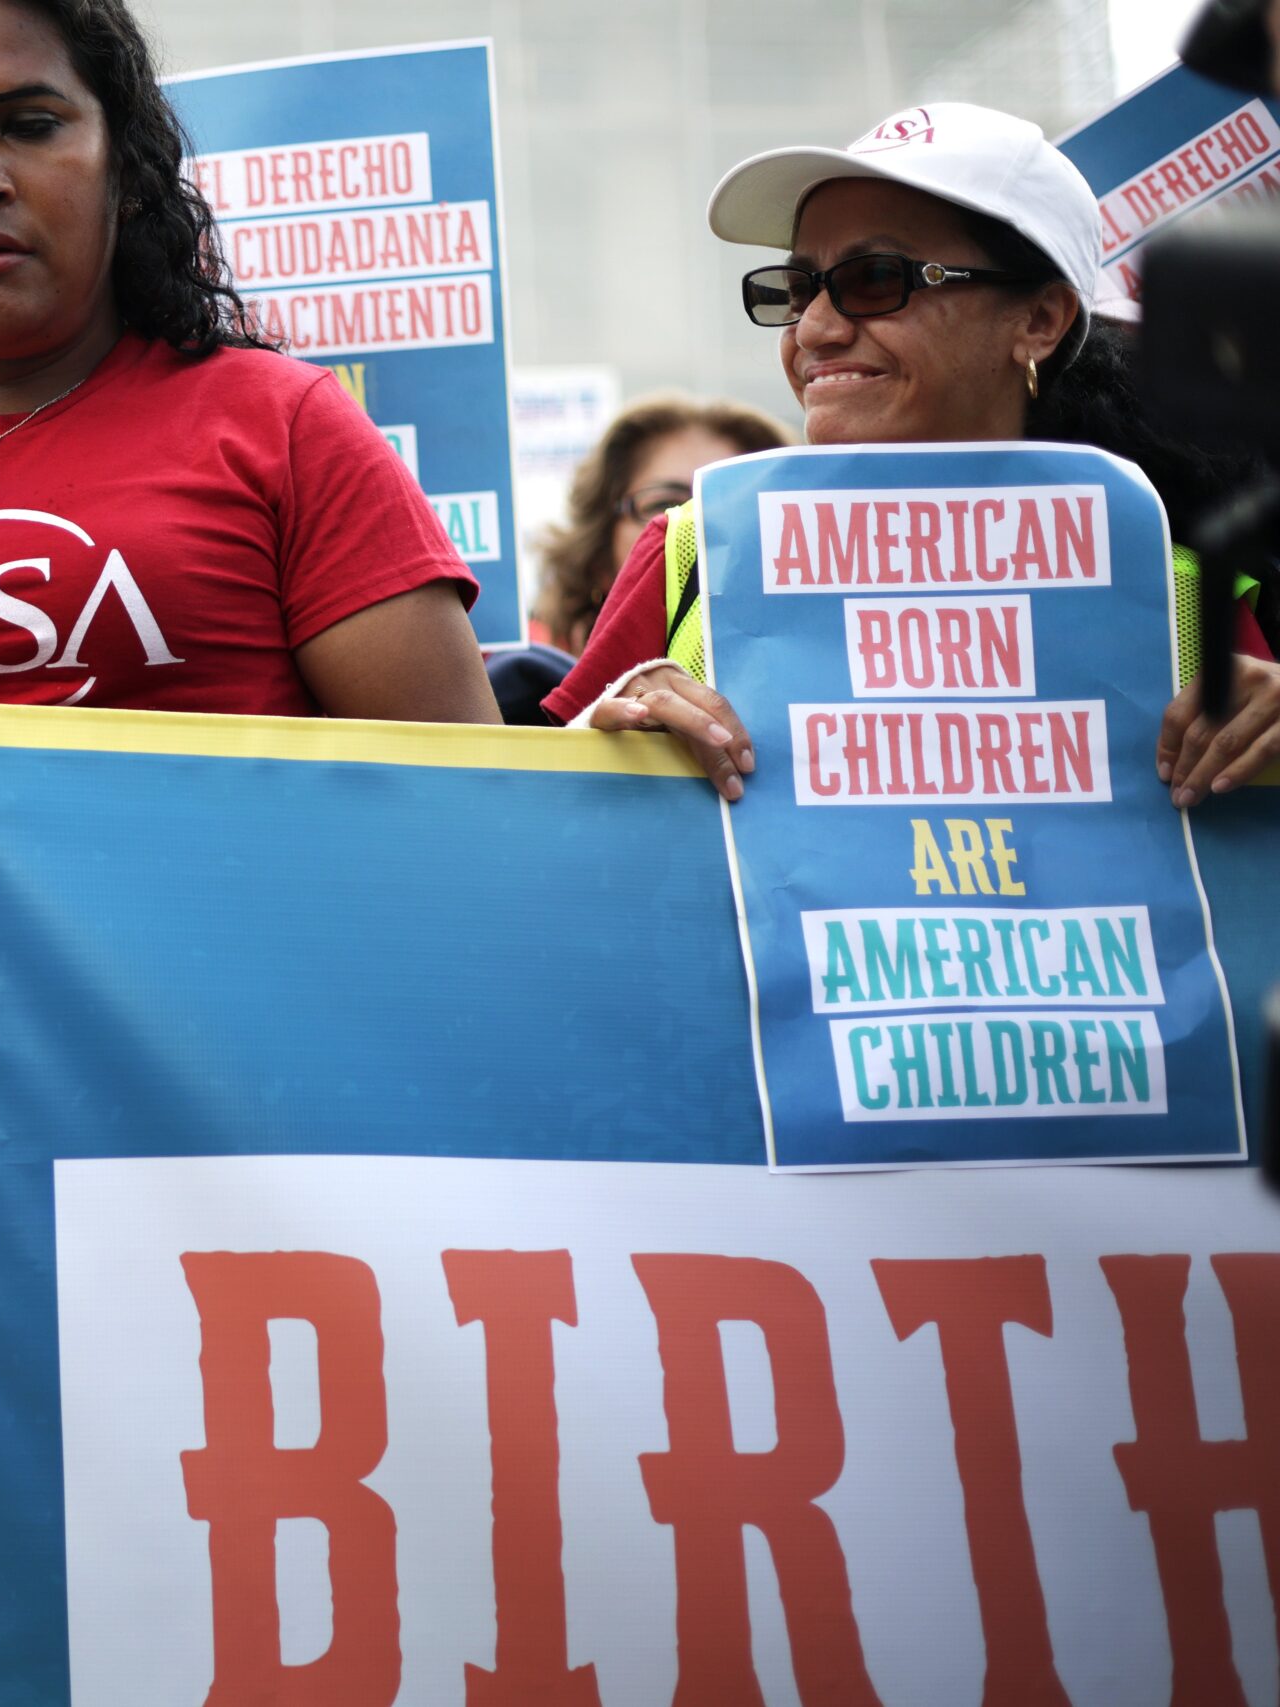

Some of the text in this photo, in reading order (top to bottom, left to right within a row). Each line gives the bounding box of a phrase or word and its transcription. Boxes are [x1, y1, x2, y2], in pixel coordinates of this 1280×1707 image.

[243, 140, 415, 208] DERECHO
[1120, 111, 1271, 228] DERECHO
[232, 201, 483, 282] CIUDADANÍA
[773, 496, 1098, 587] AMERICAN
[857, 605, 1022, 690] BORN
[805, 711, 1095, 796] CHILDREN
[909, 818, 1027, 896] ARE
[821, 917, 1150, 1004] AMERICAN
[848, 1019, 1151, 1111] CHILDREN
[179, 1247, 1280, 1707] BIRTH
